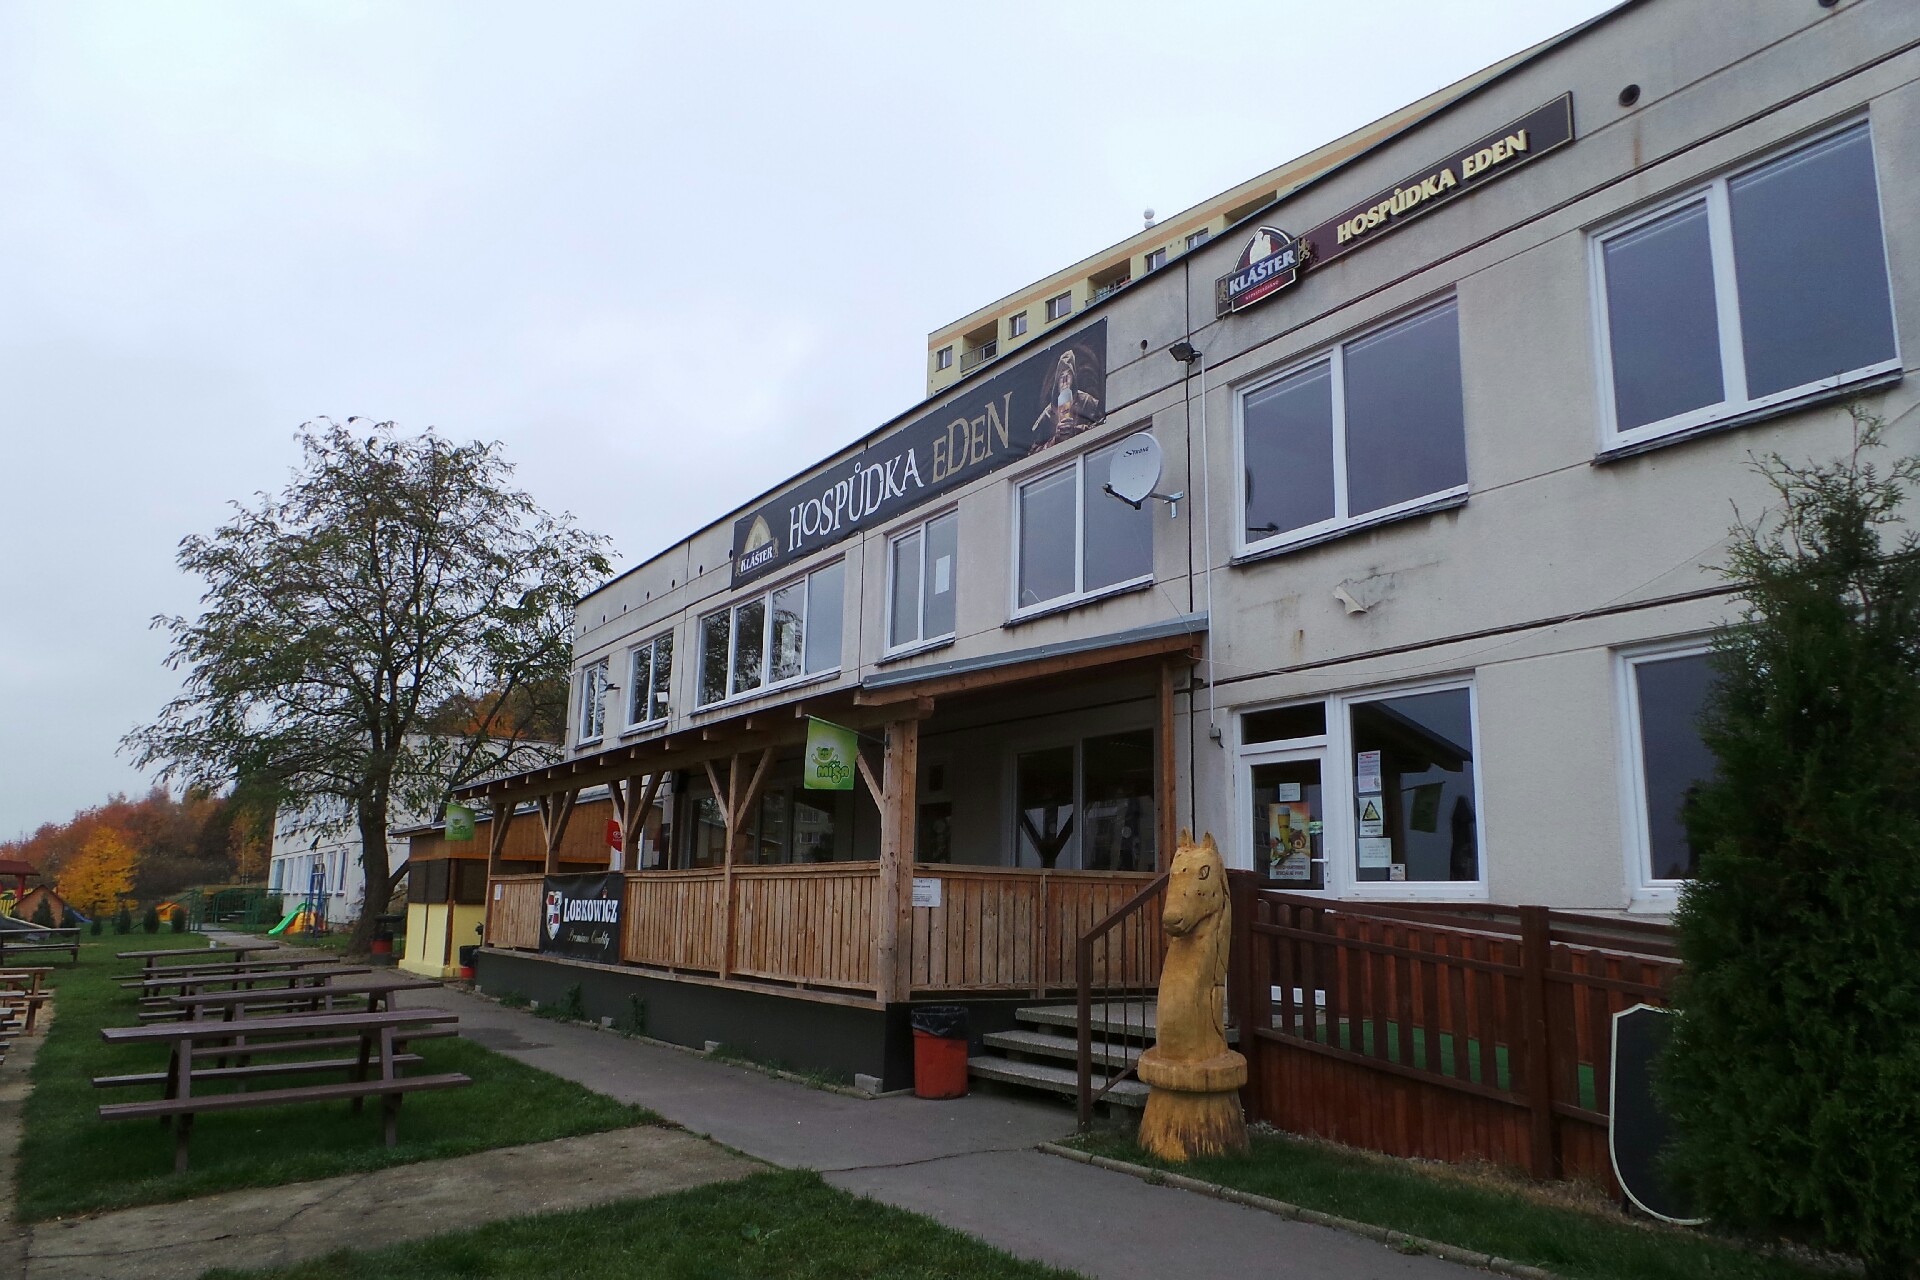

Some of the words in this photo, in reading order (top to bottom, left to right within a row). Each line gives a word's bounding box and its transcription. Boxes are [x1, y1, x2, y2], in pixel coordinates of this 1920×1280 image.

[1337, 168, 1457, 244] HOSPŮDKA
[1462, 128, 1528, 180] EDEN
[1229, 249, 1296, 296] KLÁŠTER
[788, 447, 925, 552] HOSPŮDKA
[931, 391, 1013, 484] EDEN
[740, 545, 774, 573] KLÁŠTER
[563, 897, 619, 923] LOBKOWICZ
